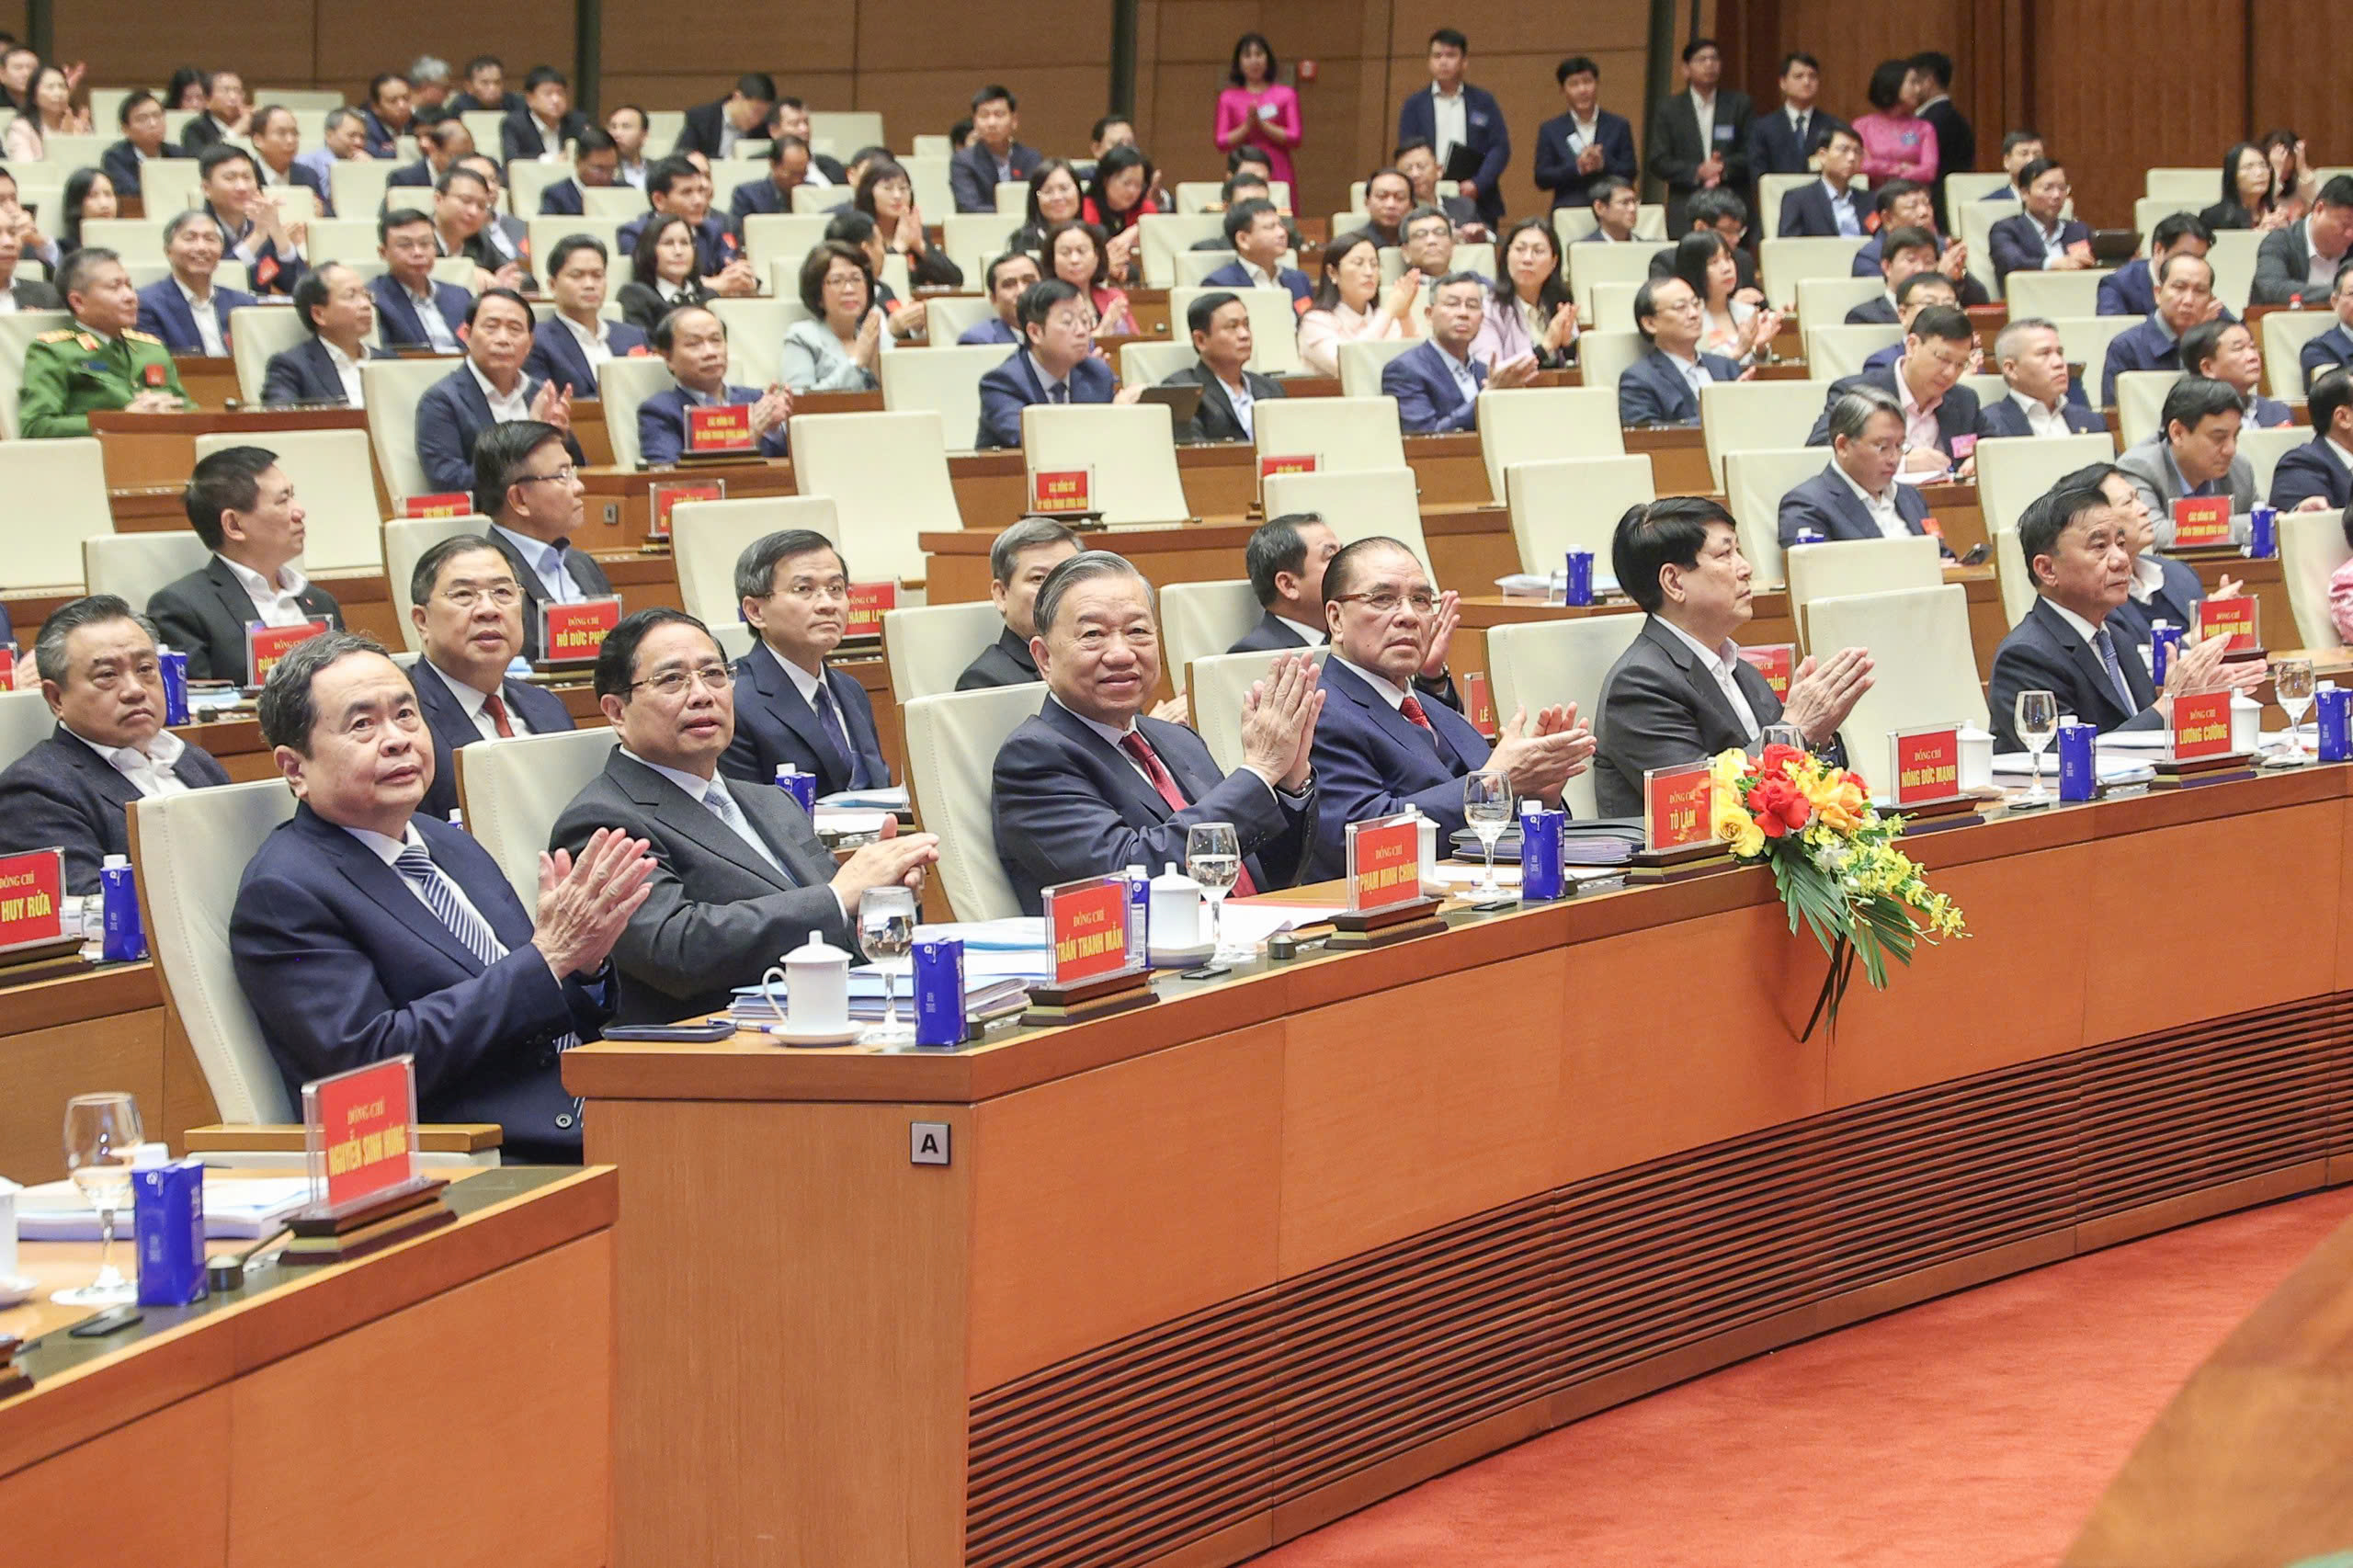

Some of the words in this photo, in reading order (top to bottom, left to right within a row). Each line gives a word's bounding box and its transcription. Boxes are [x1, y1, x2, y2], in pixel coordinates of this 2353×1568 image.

[1, 898, 24, 922] HUY
[1078, 933, 1104, 959] THANH
[921, 1133, 939, 1153] A
